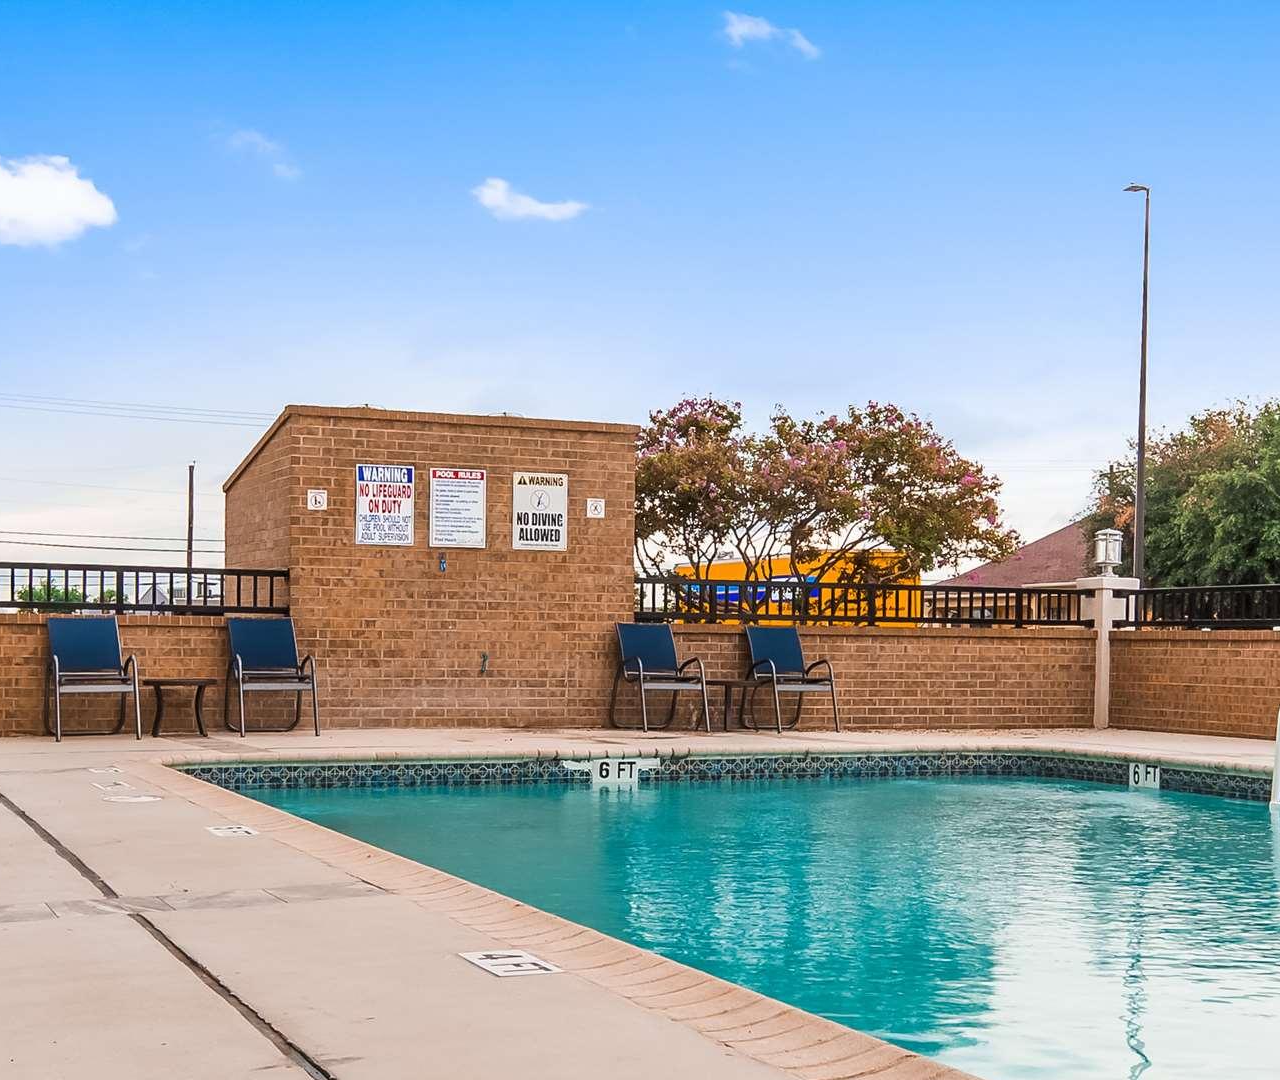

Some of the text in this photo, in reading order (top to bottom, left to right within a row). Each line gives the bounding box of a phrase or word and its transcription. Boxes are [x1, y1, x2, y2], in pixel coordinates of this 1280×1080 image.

[362, 467, 408, 483] WARNING
[528, 476, 564, 487] WARNING
[359, 484, 412, 499] NO LIFEGUARD
[368, 500, 402, 514] ON DUTY
[359, 514, 411, 524] CHILDREN SHOULD NOT
[516, 512, 563, 527] NO DIVING
[361, 523, 409, 533] USE POOL WITHOUT
[518, 528, 561, 542] ALLOWED
[361, 532, 409, 541] ADULT SUPERVISION
[599, 761, 636, 779] 6 FT
[1133, 764, 1158, 785] 6 FT
[477, 953, 553, 973] 4 FT
